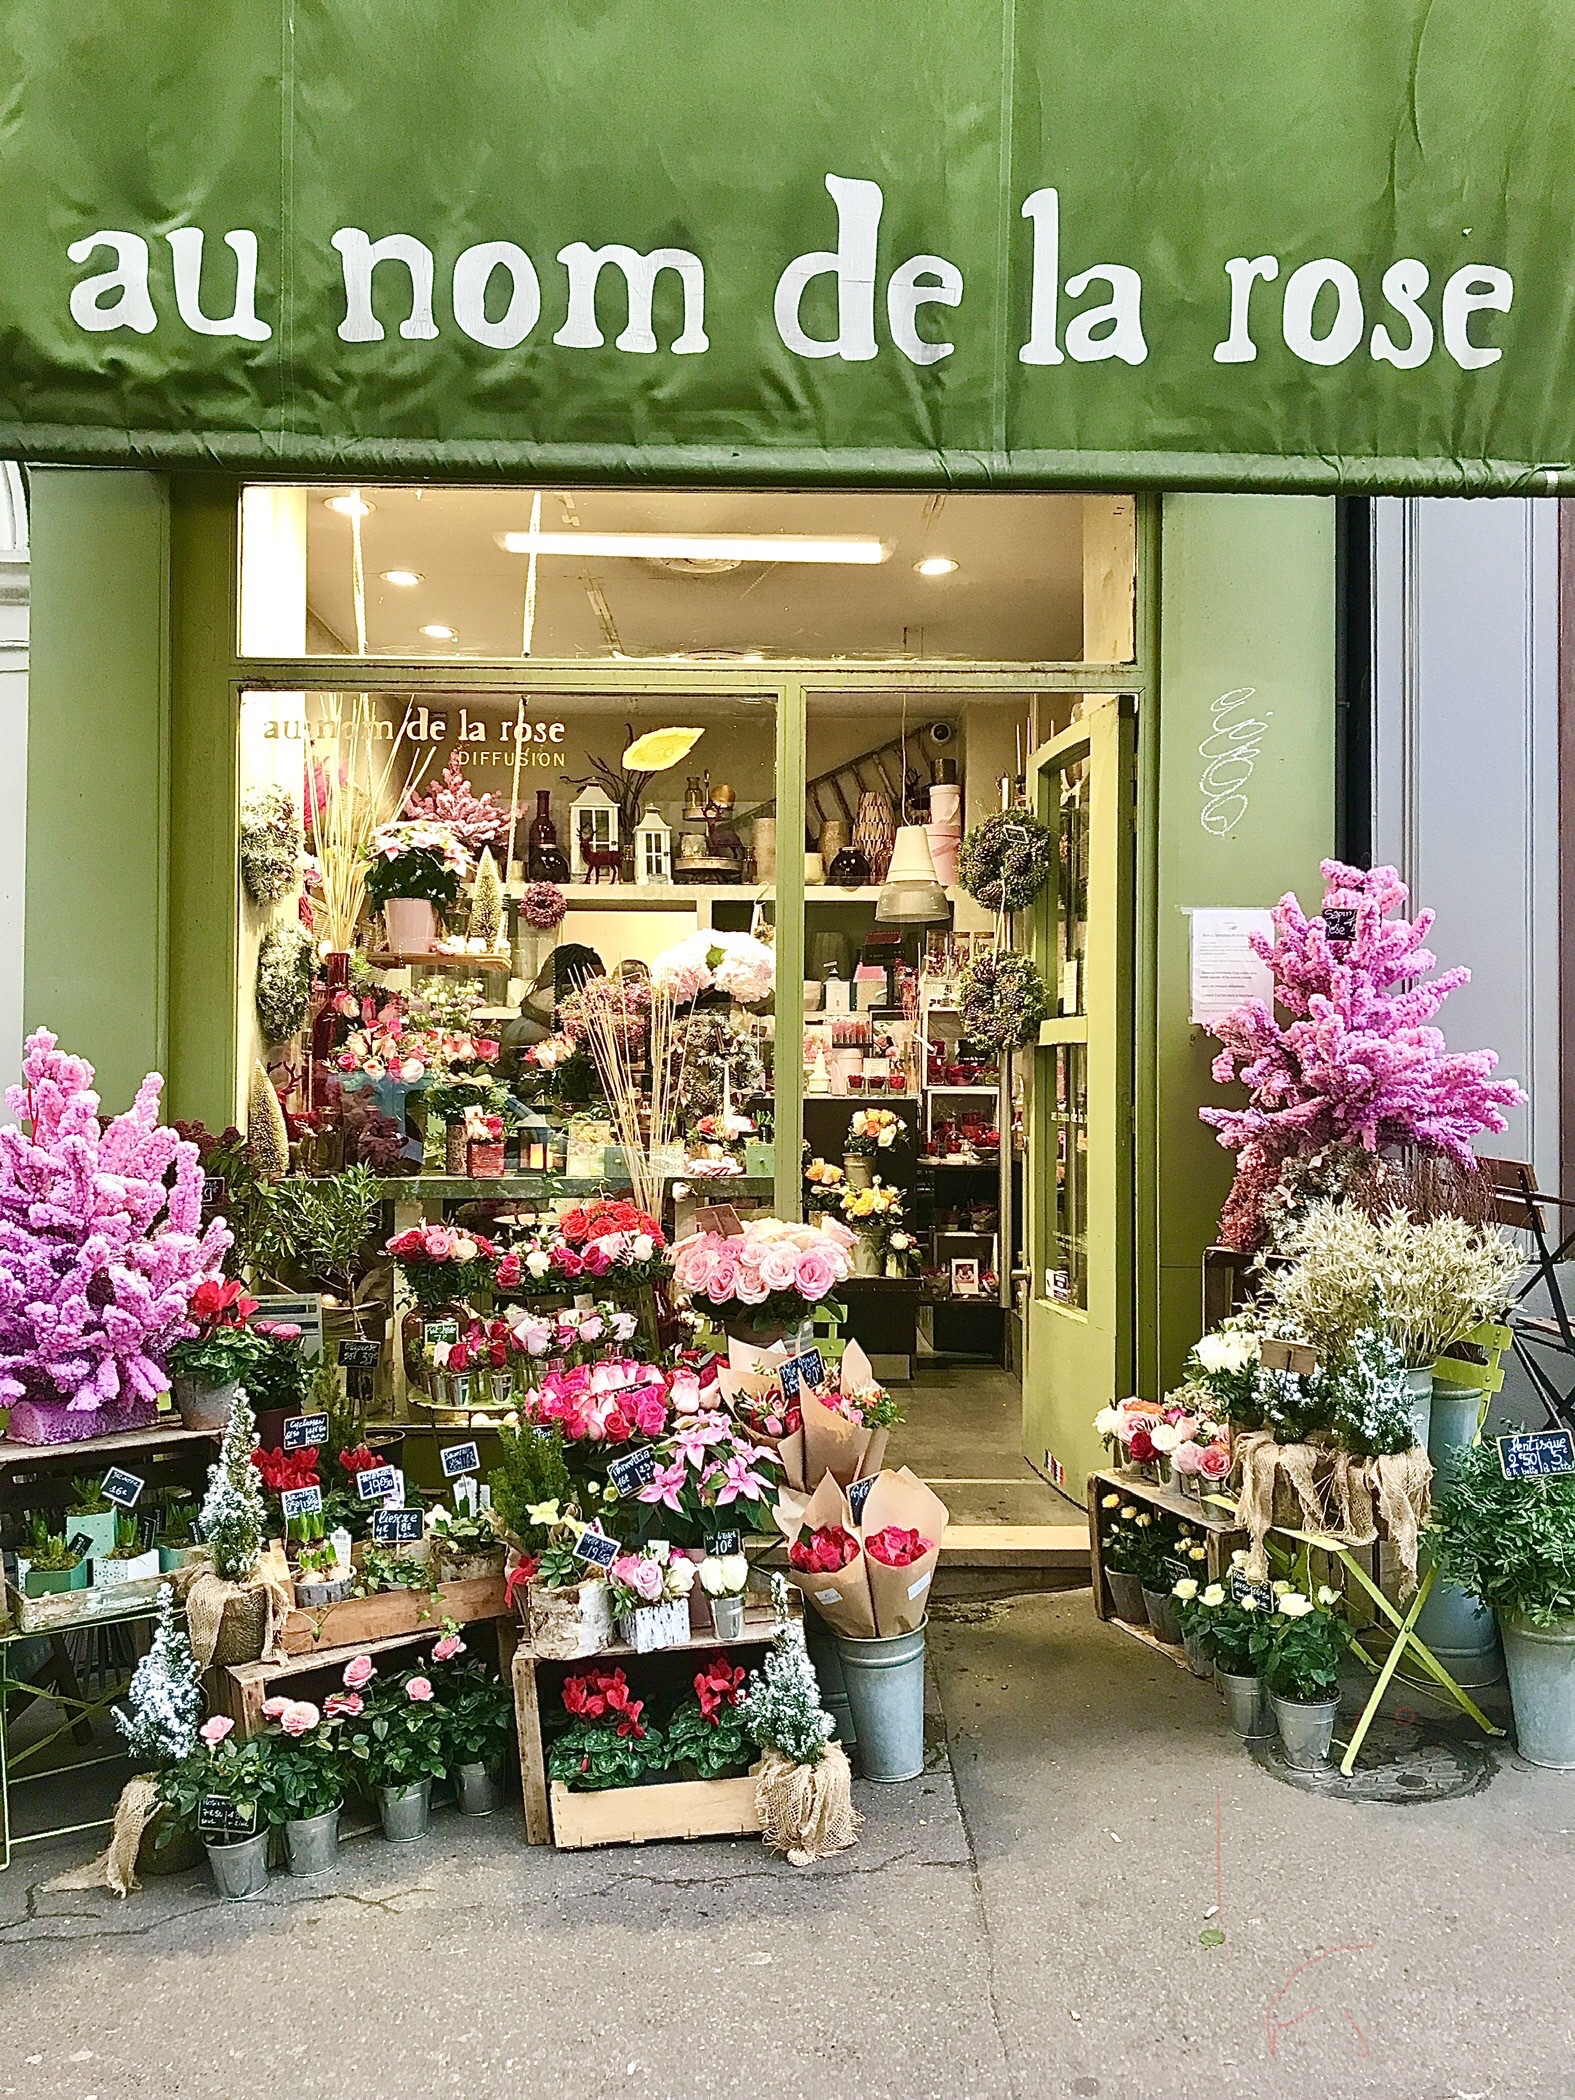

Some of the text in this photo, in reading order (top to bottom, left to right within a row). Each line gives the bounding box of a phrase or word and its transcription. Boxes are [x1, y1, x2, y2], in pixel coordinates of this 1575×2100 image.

[67, 173, 1514, 370] au nom de la rose
[263, 707, 565, 743] au nom de la rose
[459, 751, 565, 767] DIFFUSION
